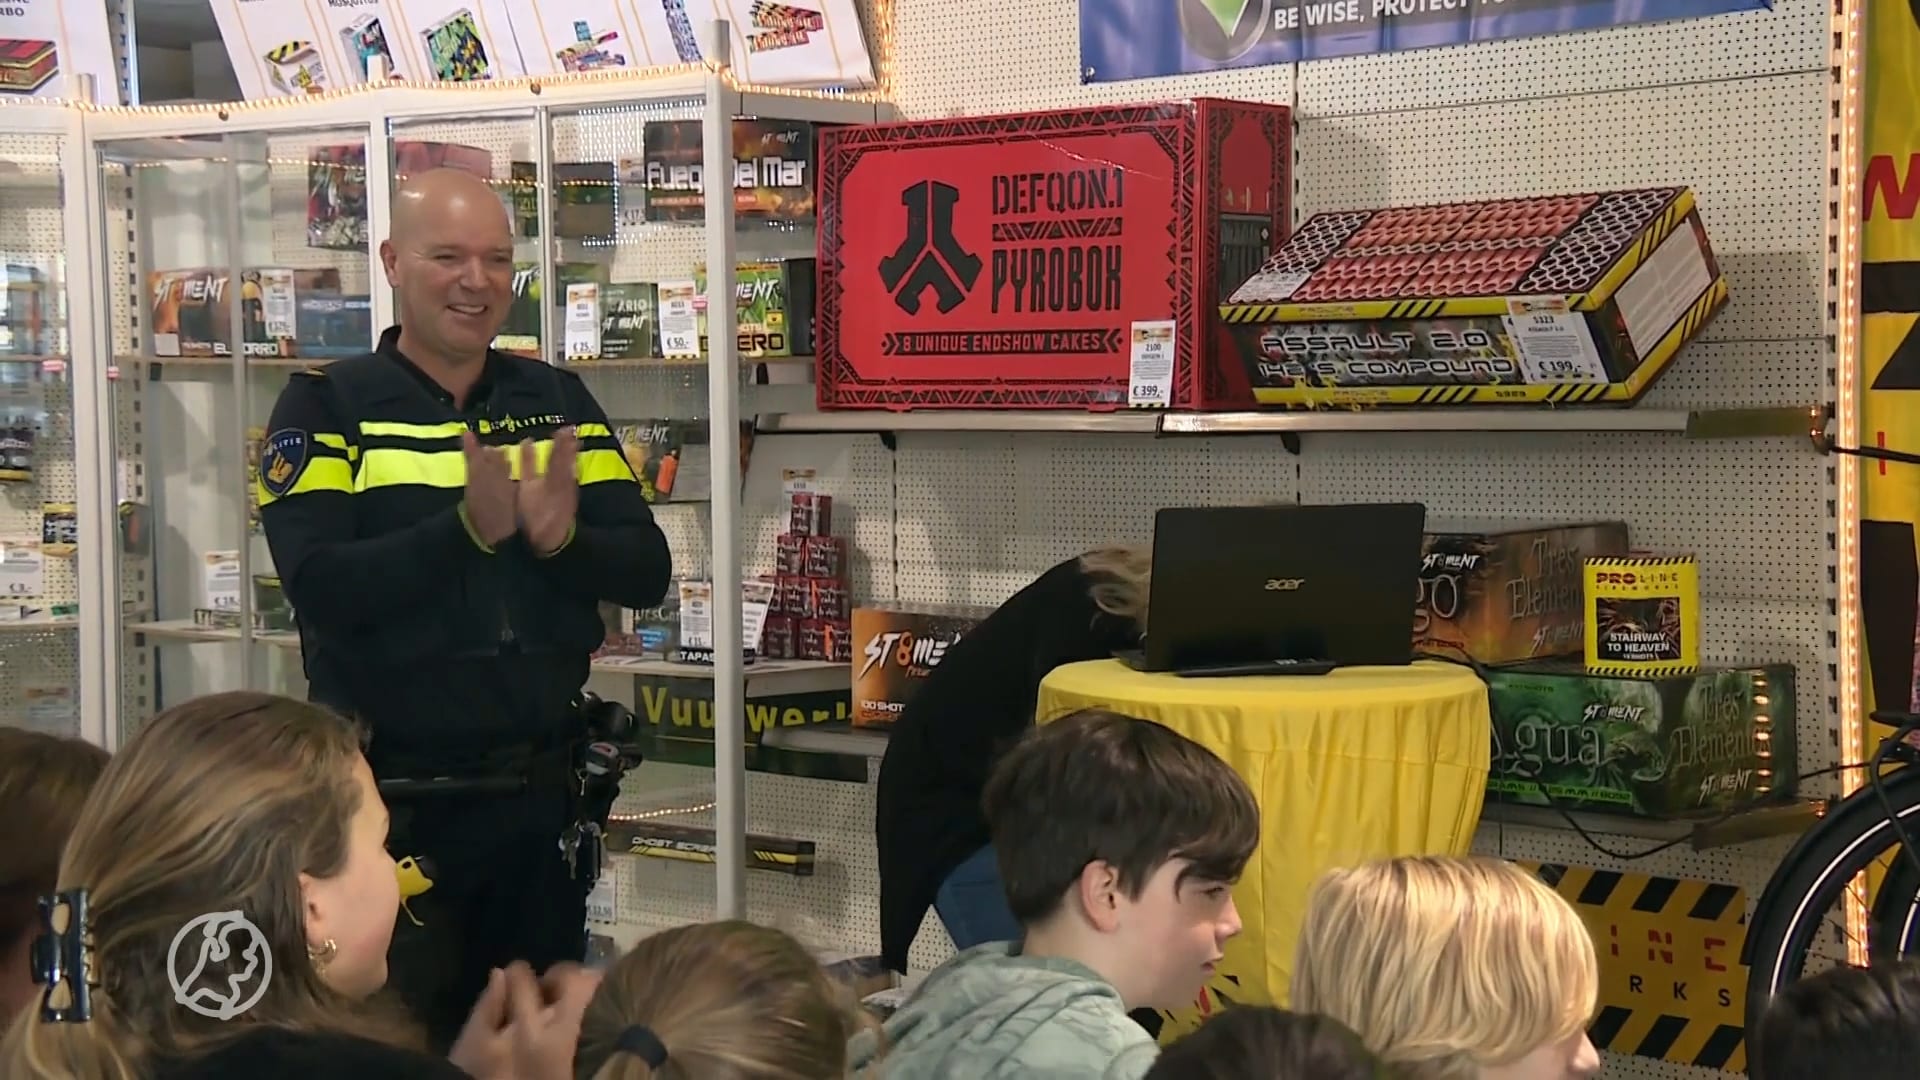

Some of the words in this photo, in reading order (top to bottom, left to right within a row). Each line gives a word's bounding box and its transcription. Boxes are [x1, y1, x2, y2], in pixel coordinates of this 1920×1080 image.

[1274, 8, 1298, 30] BE
[1304, 4, 1365, 27] WISE,
[648, 161, 703, 194] Fueg
[763, 157, 806, 187] Mar
[992, 167, 1124, 215] DEFQON.1
[991, 245, 1121, 314] PYROBOX
[903, 336, 910, 350] 8
[914, 336, 968, 351] UNIQUE
[973, 334, 1046, 350] ENDSHOW
[1051, 333, 1100, 349] CAKES
[1260, 332, 1415, 353] ASSAULT
[1430, 329, 1491, 351] 2.0
[1347, 358, 1513, 376] COMPOUND
[1264, 578, 1305, 591] acer
[1606, 643, 1622, 652] TO
[1624, 642, 1670, 653] HEAVEN
[1610, 632, 1667, 642] STAIRWAY
